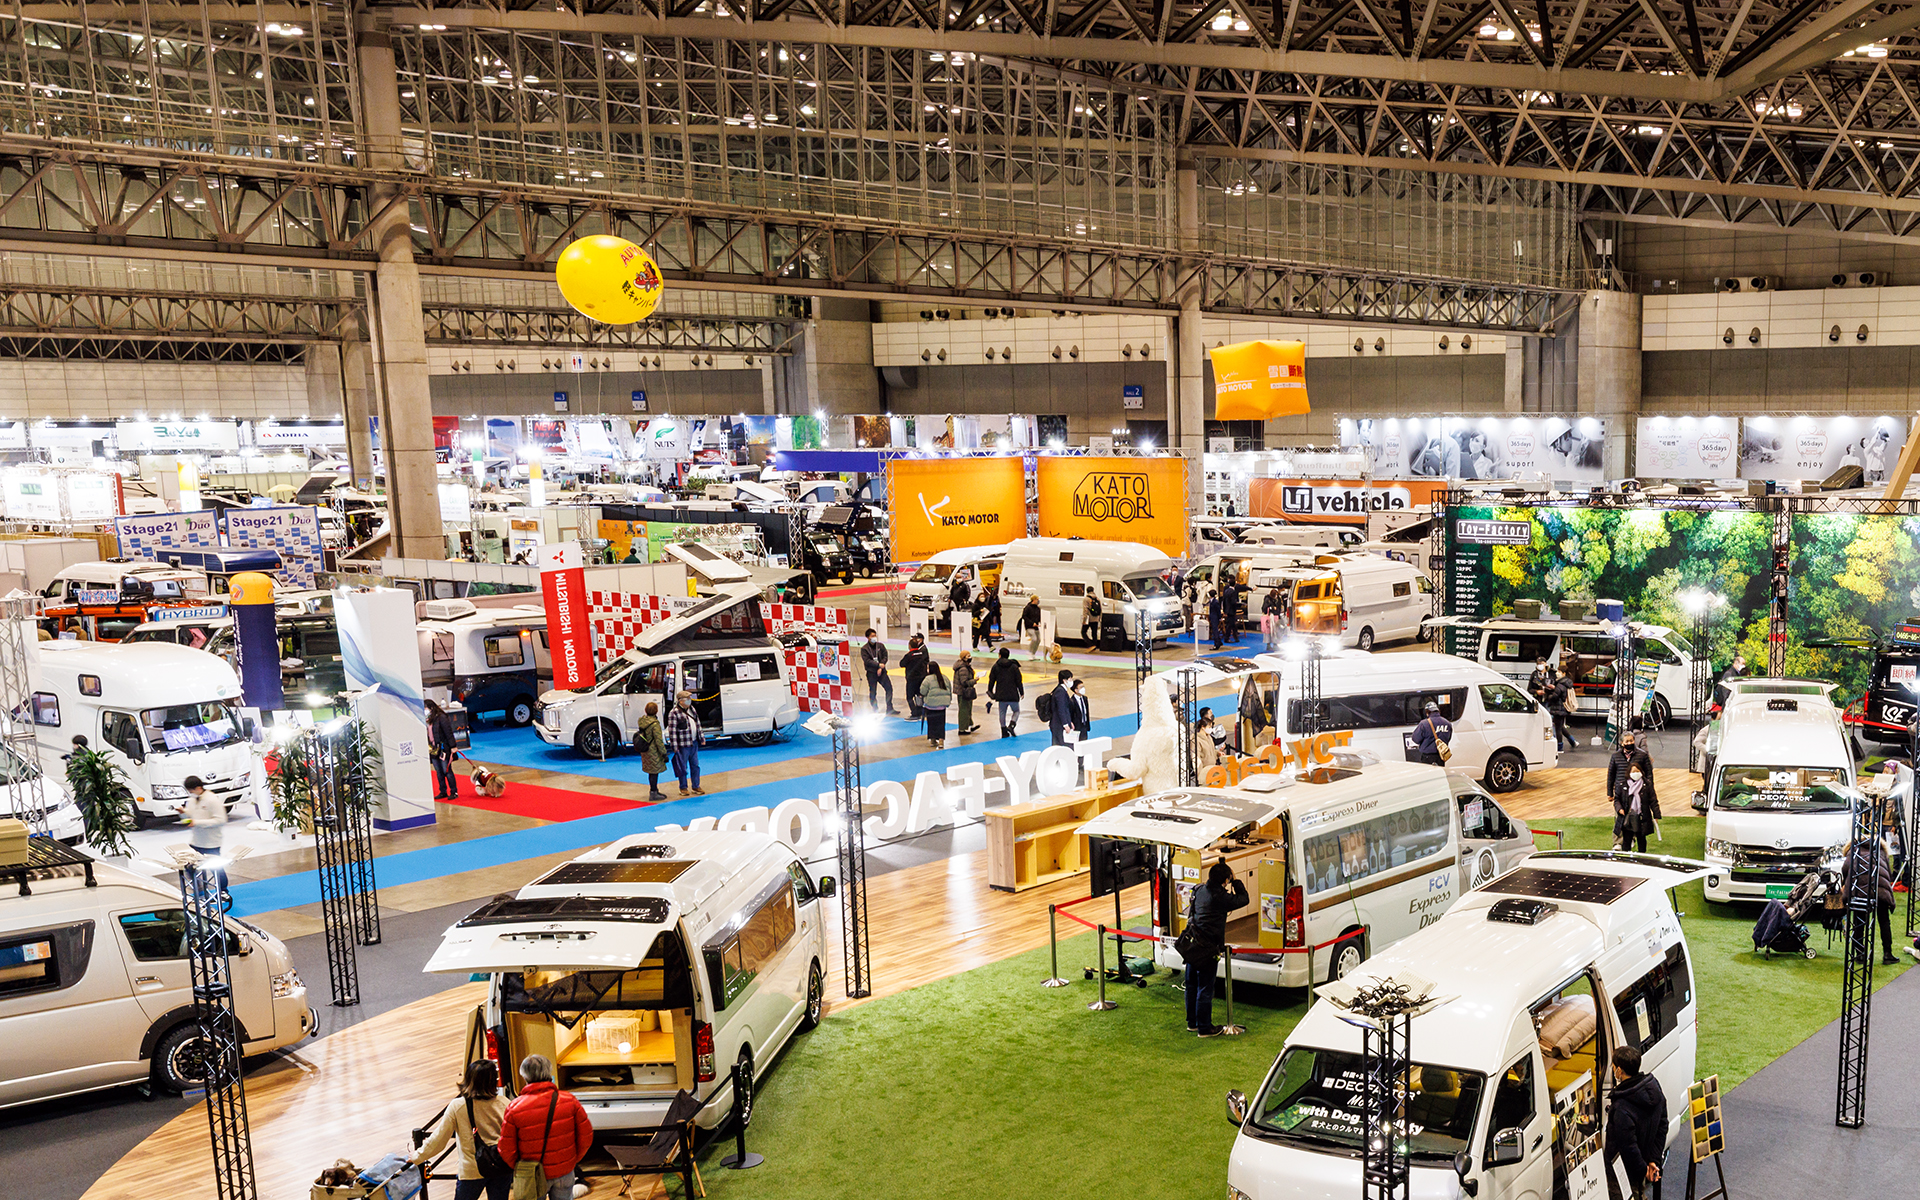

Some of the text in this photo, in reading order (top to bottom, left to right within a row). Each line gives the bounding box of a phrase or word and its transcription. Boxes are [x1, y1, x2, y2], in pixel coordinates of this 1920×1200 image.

[1135, 387, 1140, 396] 2
[533, 421, 557, 431] NEW
[1505, 460, 1535, 468] suport
[1796, 459, 1824, 469] enjoy
[1093, 475, 1145, 495] KATO
[1075, 493, 1155, 523] MOTOR
[1316, 490, 1405, 513] vehicle
[187, 520, 211, 532] Duo
[232, 515, 283, 528] Stage21
[290, 514, 312, 526] Duo
[942, 513, 999, 527] KATO MOTOR
[122, 520, 178, 536] Stage21
[1460, 522, 1528, 538] Toy-Factory
[162, 607, 220, 620] HYBRID
[1435, 724, 1449, 734] JAL
[1759, 793, 1811, 802] DEOFACTOR
[1321, 805, 1354, 823] Express
[1355, 799, 1379, 813] Diner
[1428, 872, 1451, 893] FCV
[1408, 890, 1451, 915] Express
[1299, 1105, 1330, 1119] with
[1331, 1109, 1361, 1125] Dog
